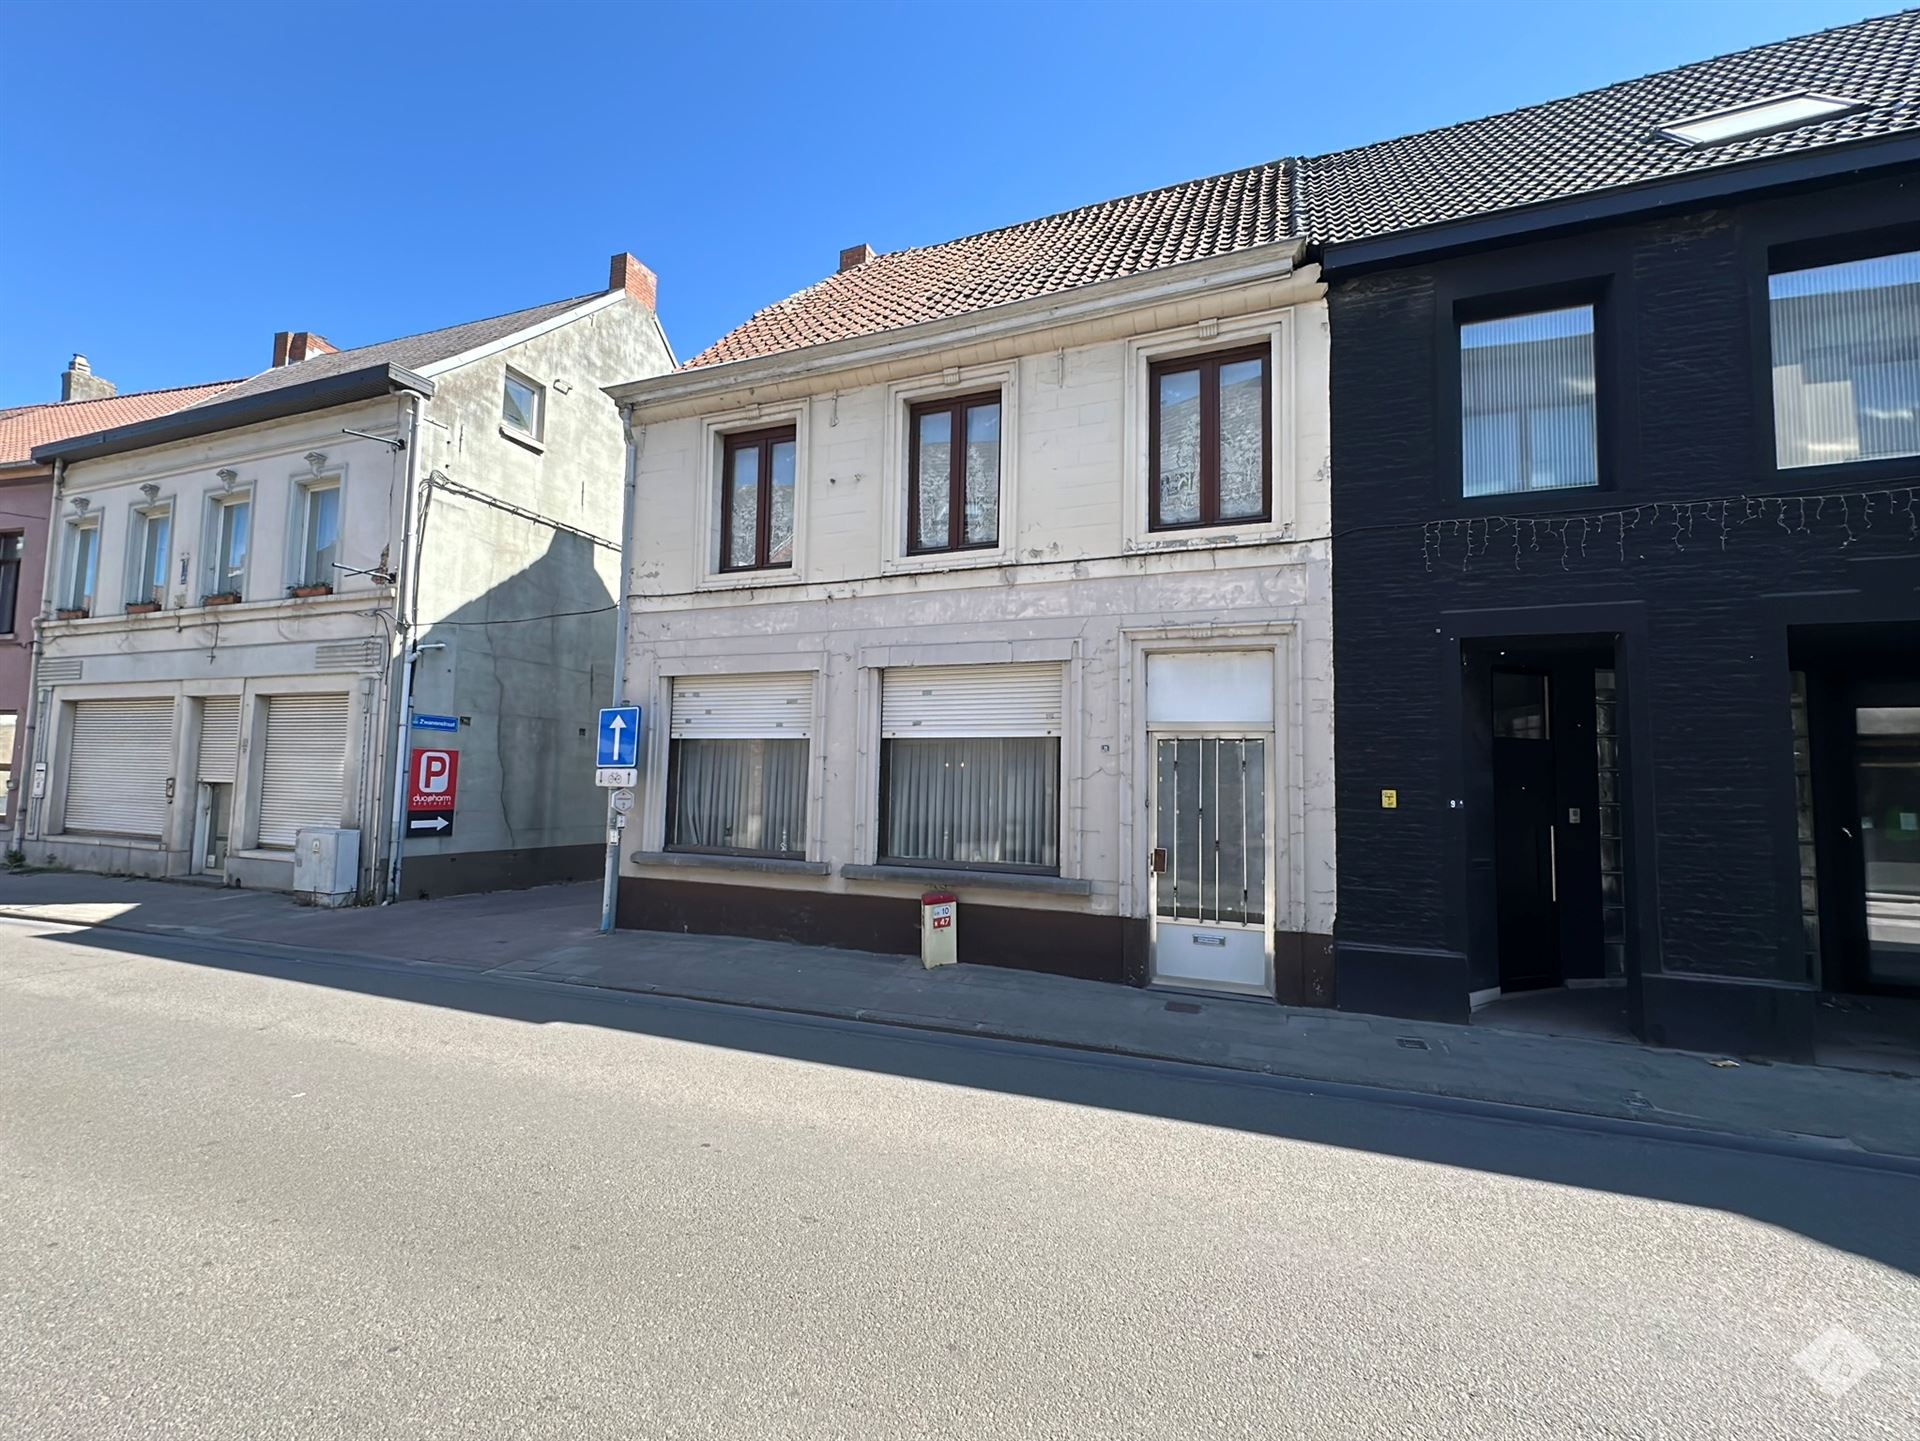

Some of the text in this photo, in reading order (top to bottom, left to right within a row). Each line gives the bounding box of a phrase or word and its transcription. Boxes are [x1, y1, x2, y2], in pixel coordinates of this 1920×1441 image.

[424, 756, 447, 788] P
[942, 907, 950, 915] 10
[940, 917, 950, 926] 47
